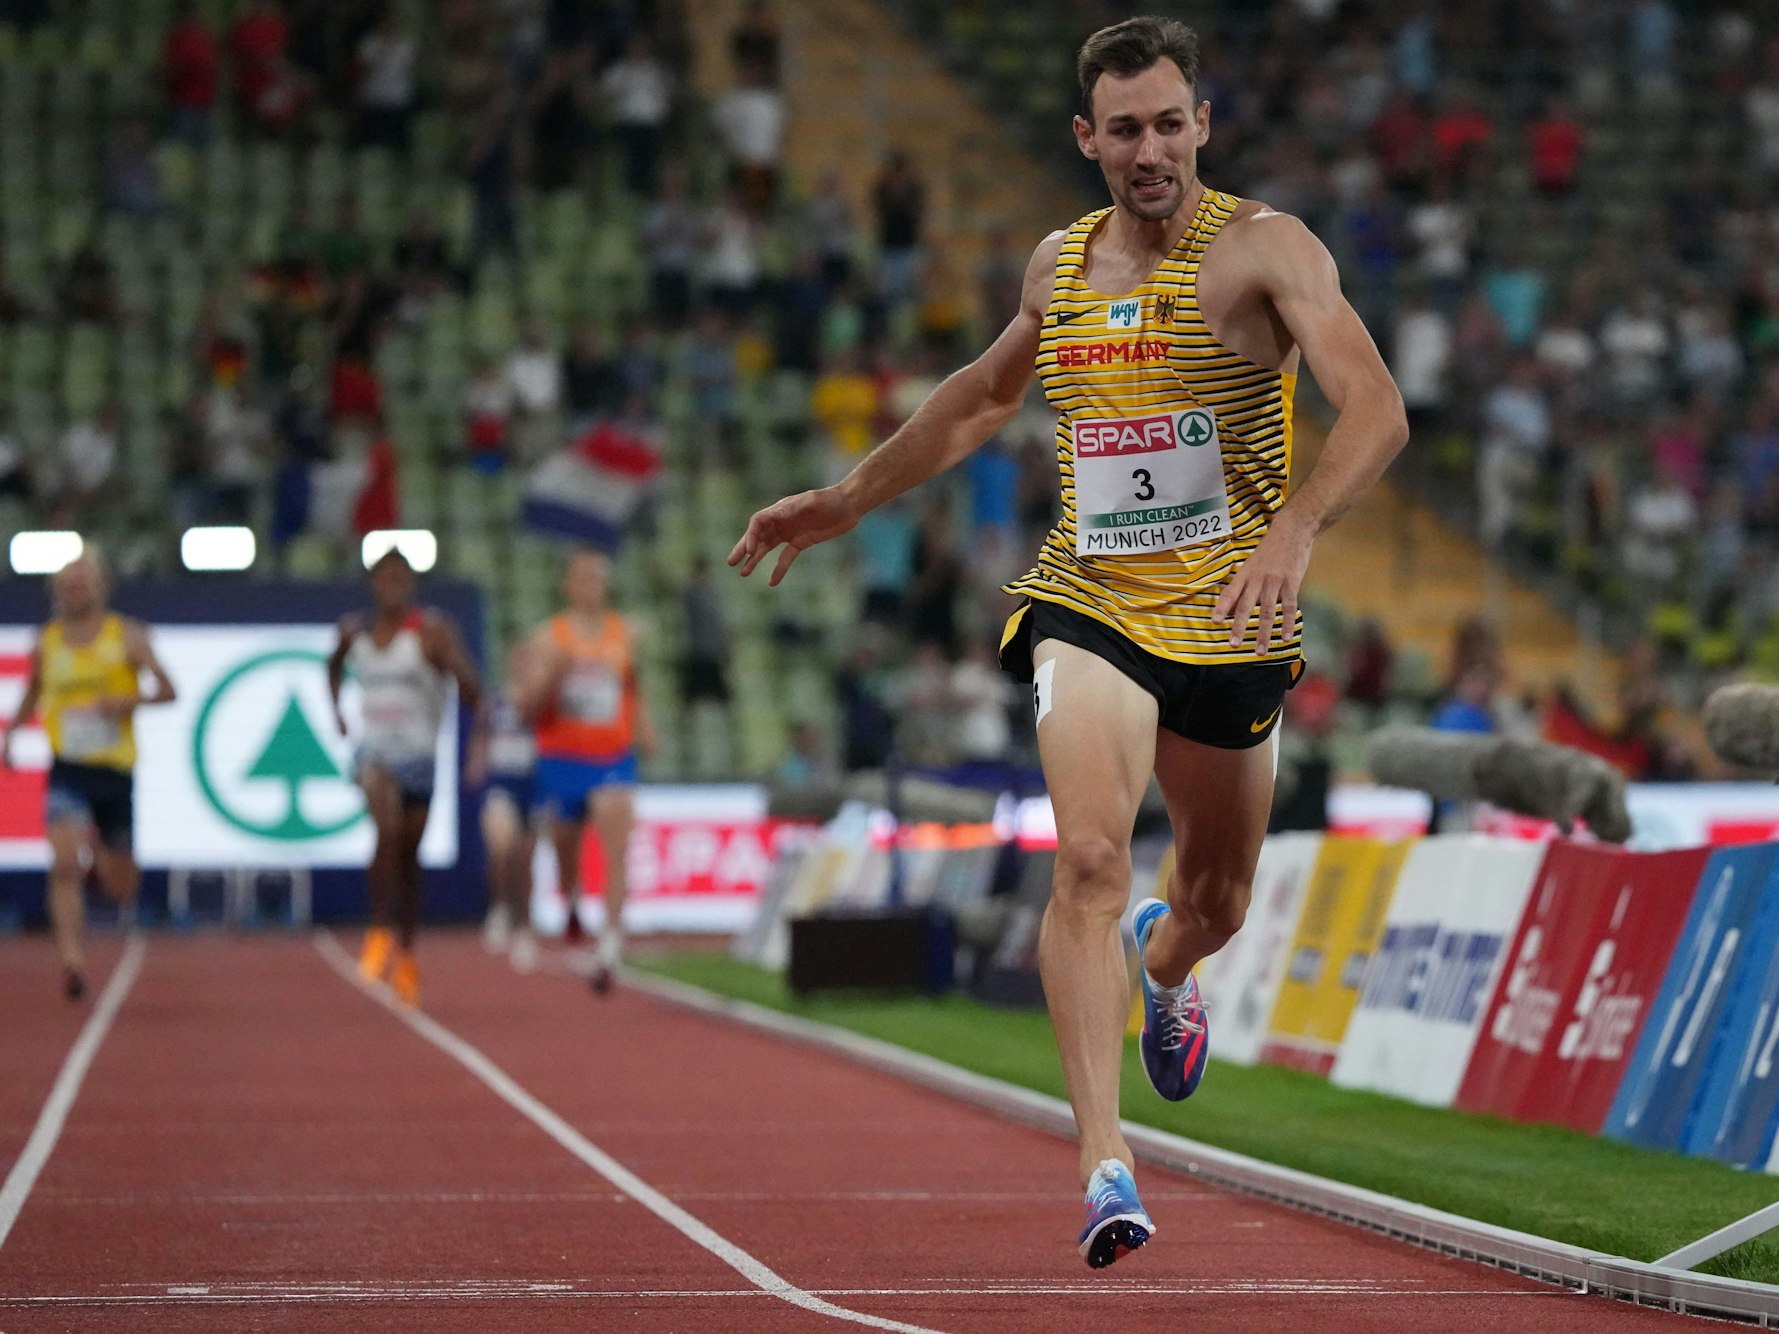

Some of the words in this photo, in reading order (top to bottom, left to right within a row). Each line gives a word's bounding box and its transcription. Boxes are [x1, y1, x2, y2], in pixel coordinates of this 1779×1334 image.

[1056, 339, 1172, 367] GERMANY
[1078, 420, 1173, 453] SPAR
[1132, 468, 1156, 501] 3
[1087, 527, 1166, 550] MUNICH
[1172, 515, 1222, 542] 2022
[1109, 515, 1114, 526] I
[1117, 511, 1143, 525] RUN
